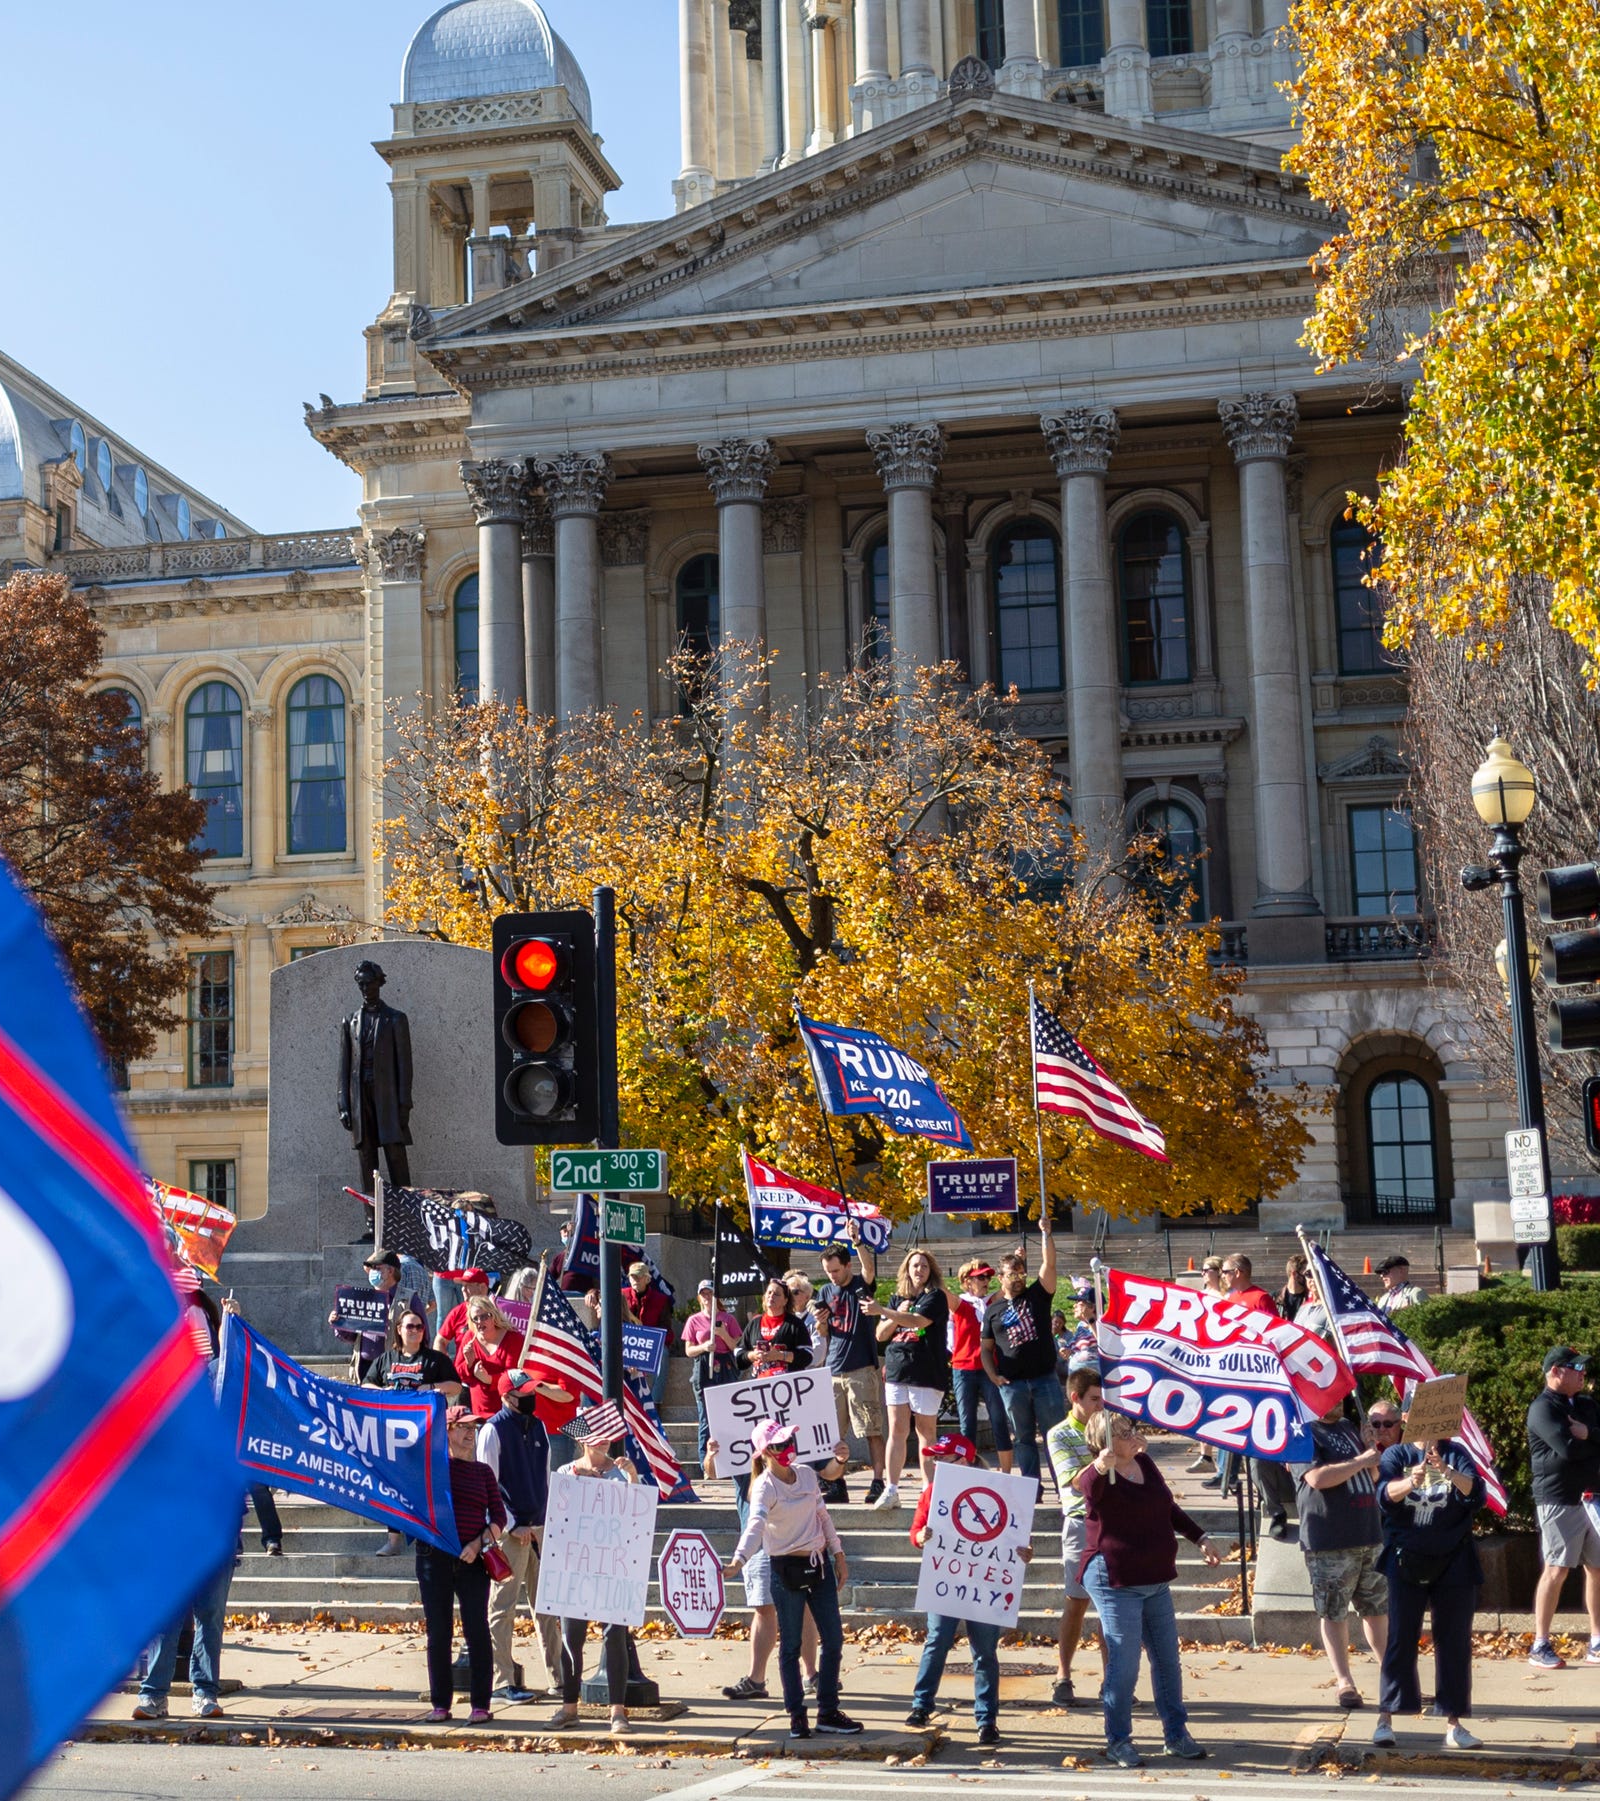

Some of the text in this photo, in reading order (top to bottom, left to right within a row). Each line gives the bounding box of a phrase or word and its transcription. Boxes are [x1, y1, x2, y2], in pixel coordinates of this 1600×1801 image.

[1514, 1135, 1531, 1148] NO
[1509, 1147, 1539, 1158] BICYCLES
[556, 1153, 656, 1186] 2nd 300 S
[628, 1172, 645, 1187] ST
[935, 1172, 1010, 1186] TRUMP
[759, 1191, 793, 1204] KEEP
[942, 1184, 1004, 1194] PENCE
[606, 1204, 627, 1237] Capitol
[630, 1207, 639, 1223] 200
[780, 1211, 883, 1246] 2020
[633, 1227, 642, 1242] AVE
[776, 1234, 814, 1246] President
[722, 1272, 756, 1285] DONT
[338, 1297, 385, 1312] TRUMP
[342, 1307, 381, 1318] PENCE
[1123, 1280, 1338, 1389] TRUMP
[1139, 1337, 1166, 1350] NO
[730, 1376, 815, 1417] STOP
[1103, 1365, 1288, 1455] 2020
[247, 1436, 294, 1461] KEEP
[296, 1451, 373, 1491] AMERICA
[557, 1479, 650, 1517] STAND
[937, 1500, 1018, 1529] STEAL
[576, 1515, 622, 1547] FOR
[564, 1541, 629, 1577] FAIR
[672, 1546, 706, 1566] STOP
[936, 1534, 1016, 1564] LEGAL
[681, 1568, 706, 1589] THE
[932, 1555, 1013, 1585] VOTES
[543, 1570, 645, 1616] ELECTIONS
[673, 1591, 716, 1612] STEAL
